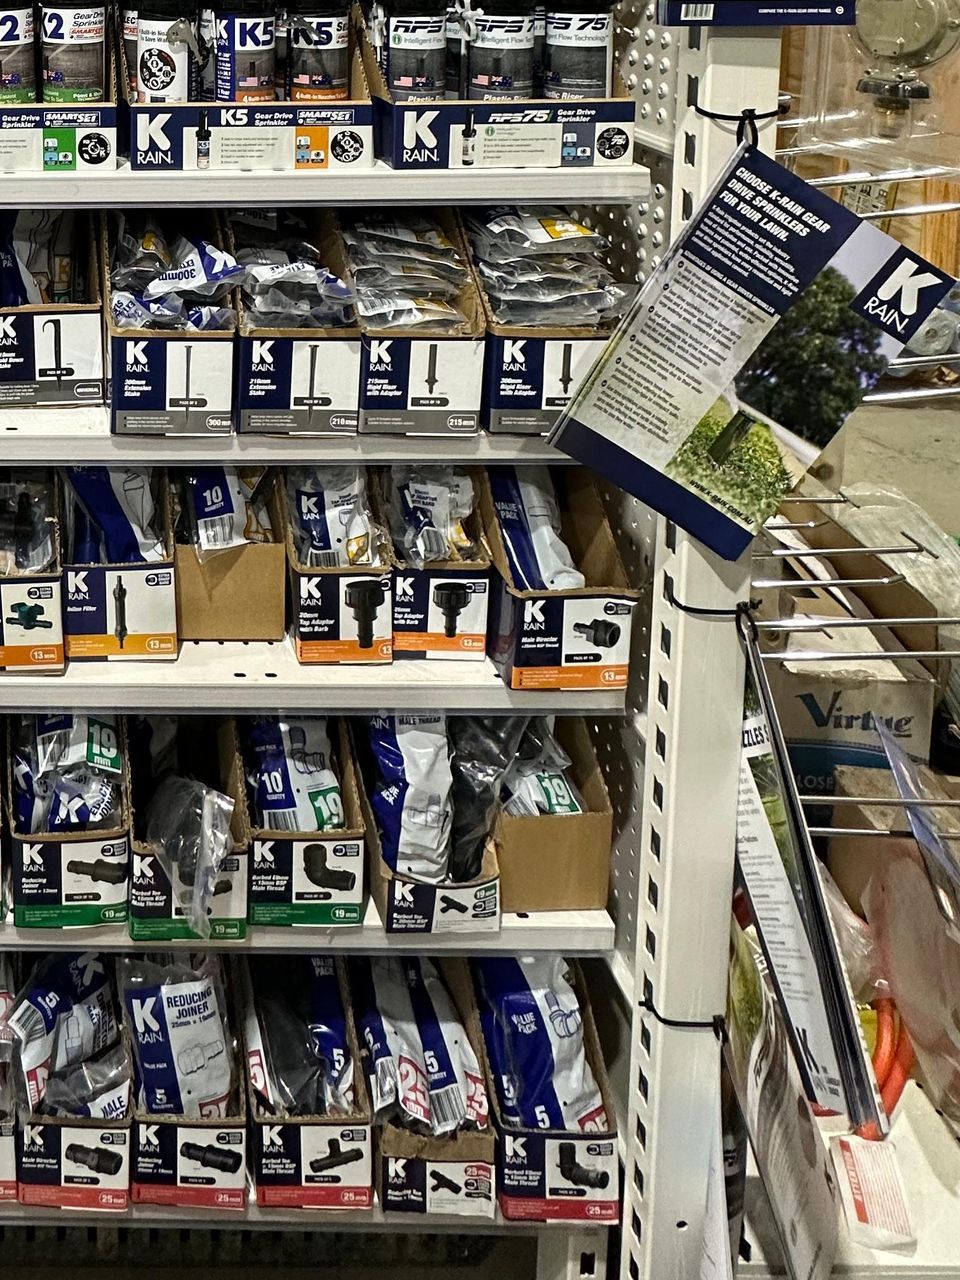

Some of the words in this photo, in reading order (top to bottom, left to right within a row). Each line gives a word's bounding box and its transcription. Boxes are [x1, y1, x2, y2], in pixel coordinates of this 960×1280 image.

[240, 22, 274, 46] K5
[45, 114, 98, 122] SMARTSET
[221, 109, 248, 125] K5
[298, 111, 352, 120] SMARTSET
[137, 114, 172, 151] K
[404, 111, 440, 149] K
[138, 152, 171, 164] RAIN
[403, 149, 438, 162] RAIN
[727, 179, 755, 201] DRIVE
[752, 197, 811, 237] SPRINKLERS
[736, 167, 772, 194] CHOOSE
[769, 188, 805, 216] K-RAIN
[802, 212, 831, 233] GEAR
[719, 191, 739, 207] FOR
[736, 201, 762, 222] YOUR
[759, 216, 788, 241] LAWN.
[878, 257, 943, 316] K
[864, 297, 905, 334] RAIN
[202, 486, 223, 506] 10
[89, 728, 118, 757] 19
[261, 772, 282, 793] 10
[544, 779, 569, 805] 19
[166, 986, 212, 1008] REDUCING
[132, 997, 159, 1032] K
[176, 1002, 209, 1019] JOINER
[512, 1012, 536, 1025] VALUE
[138, 1032, 164, 1043] RAIN
[518, 1022, 537, 1034] PACK
[155, 1089, 167, 1104] 5
